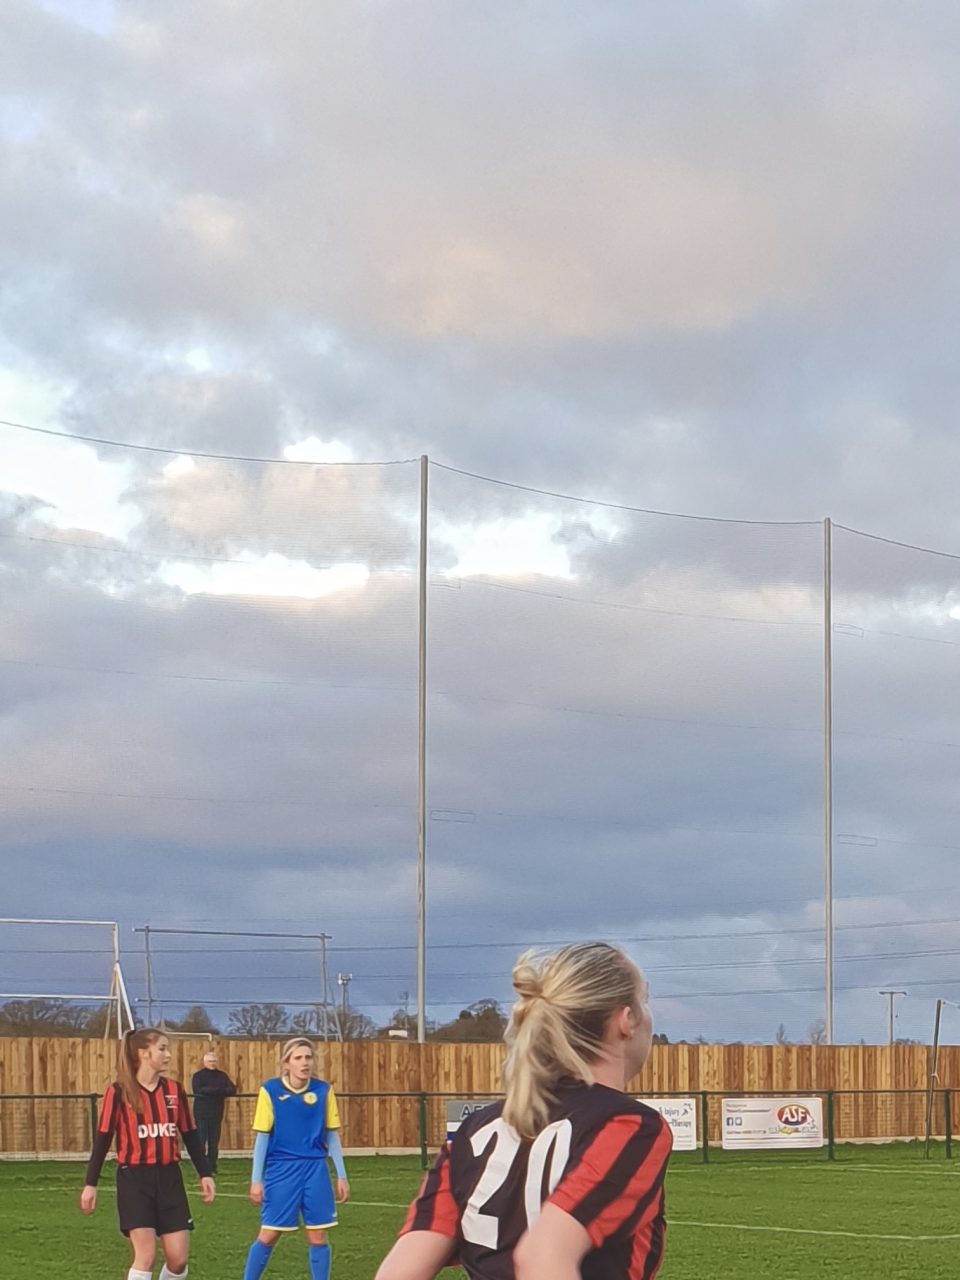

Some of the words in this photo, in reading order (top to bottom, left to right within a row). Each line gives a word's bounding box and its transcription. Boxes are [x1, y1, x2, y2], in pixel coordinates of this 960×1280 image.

[781, 1106, 807, 1122] ASF
[138, 1122, 177, 1139] DUKE
[461, 1117, 573, 1250] 20
